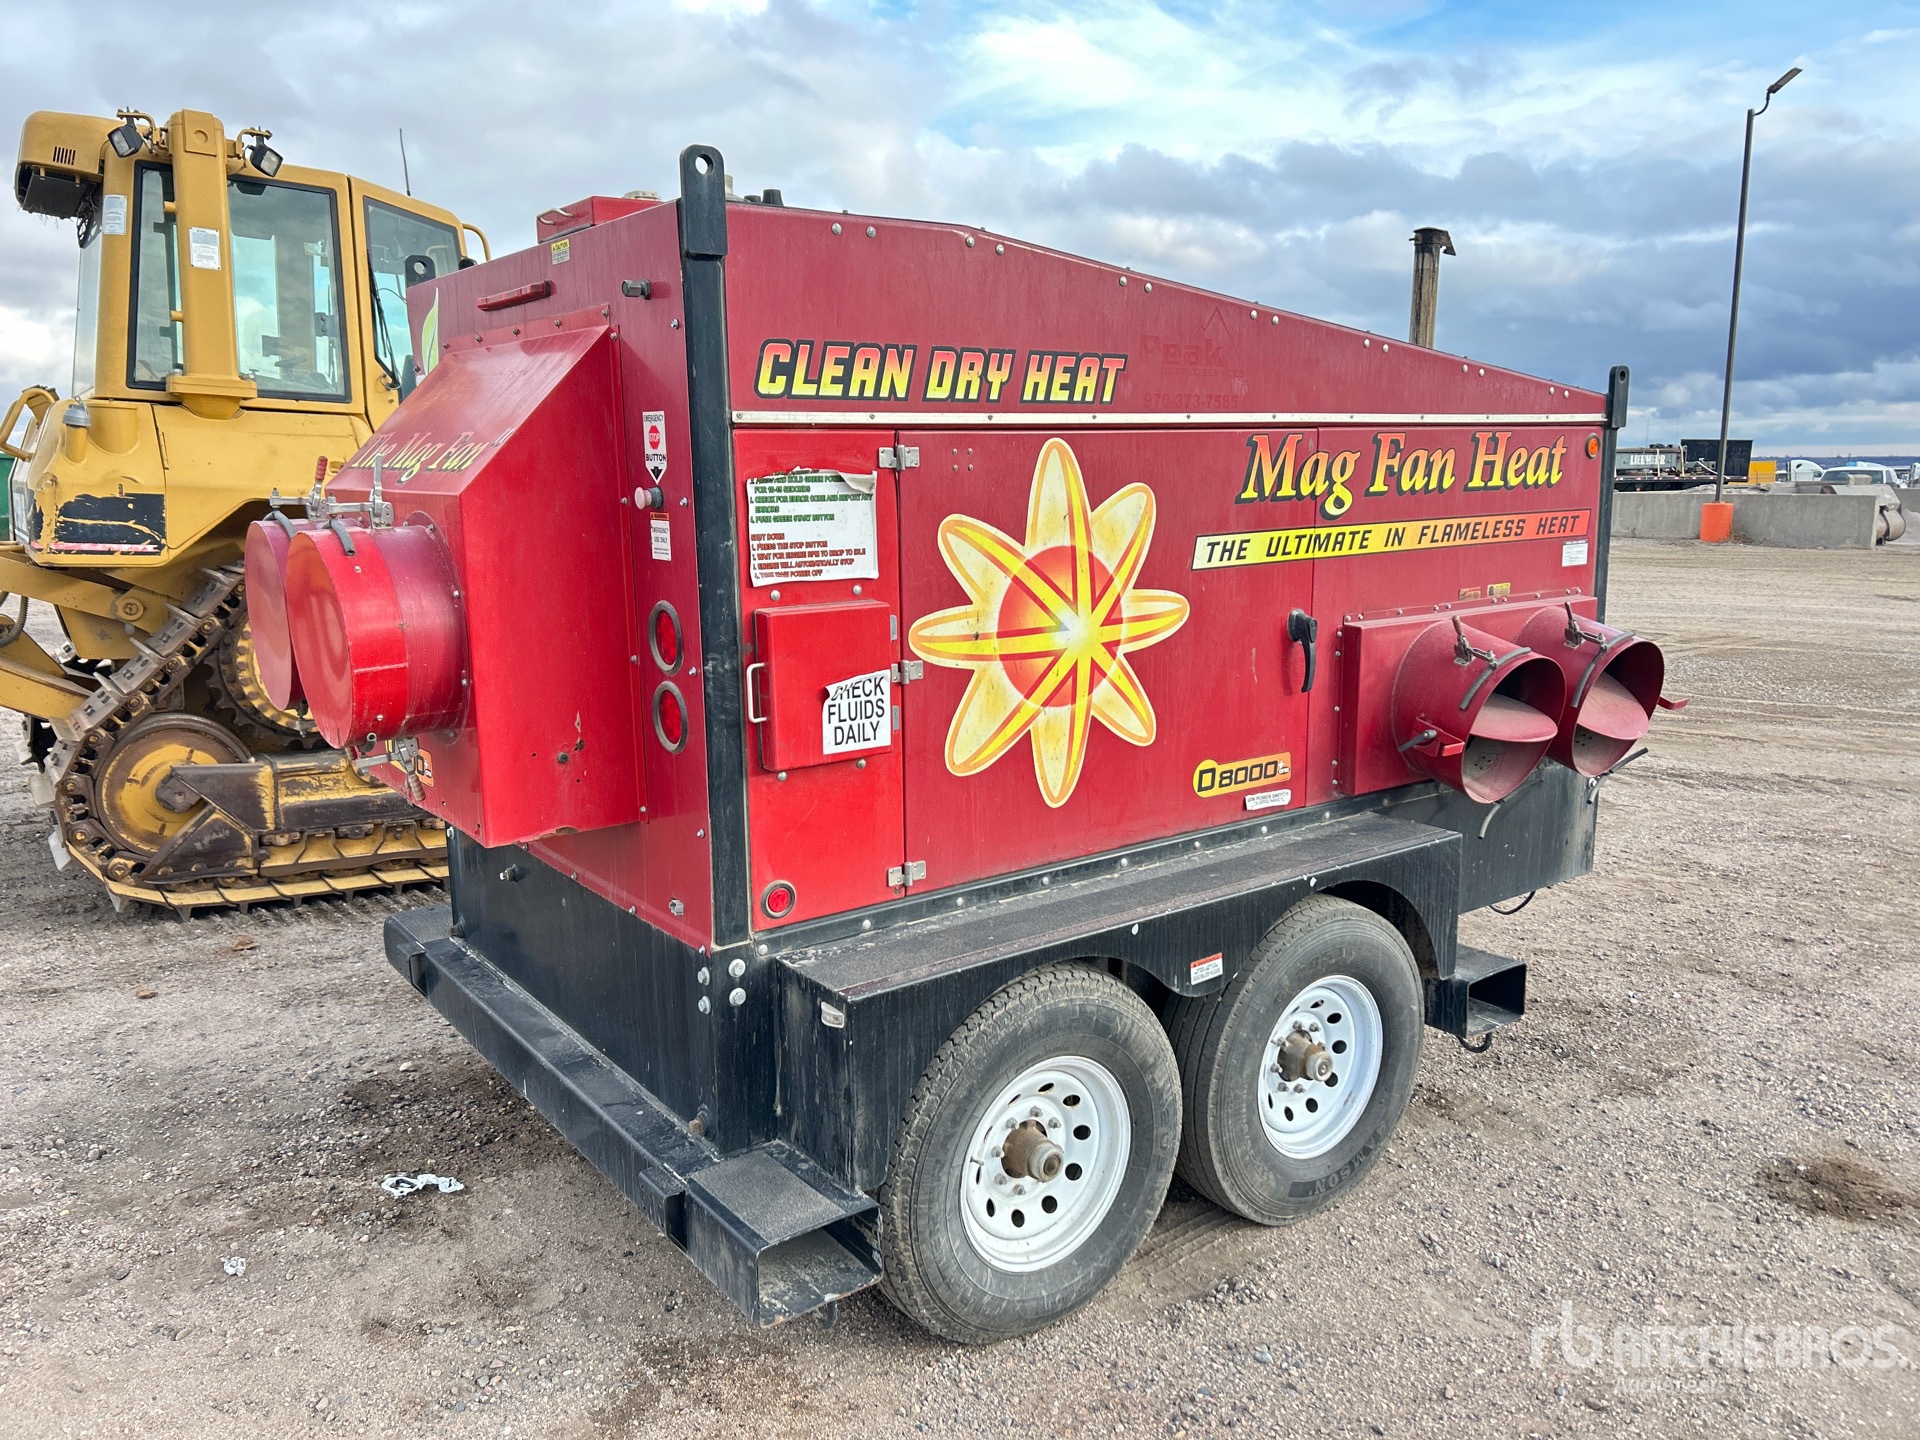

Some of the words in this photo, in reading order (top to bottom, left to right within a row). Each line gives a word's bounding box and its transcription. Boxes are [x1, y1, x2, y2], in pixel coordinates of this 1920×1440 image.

[1140, 335, 1225, 367] Peak
[755, 340, 916, 400] CLEAN
[924, 346, 1016, 402] DRY
[1021, 351, 1127, 404] HEAT
[649, 432, 660, 443] STOP
[382, 432, 446, 484] Mag
[1236, 432, 1361, 521] Mag
[1364, 432, 1457, 497] Fan
[1463, 431, 1567, 492] Heat
[1206, 539, 1250, 564] THE
[1266, 529, 1372, 559] ULTIMATE
[1385, 527, 1406, 547] IN
[1418, 519, 1526, 545] FLAMELESS
[1536, 515, 1580, 535] HEAT
[828, 698, 885, 724] FLUIDS
[834, 720, 880, 746] DAILY
